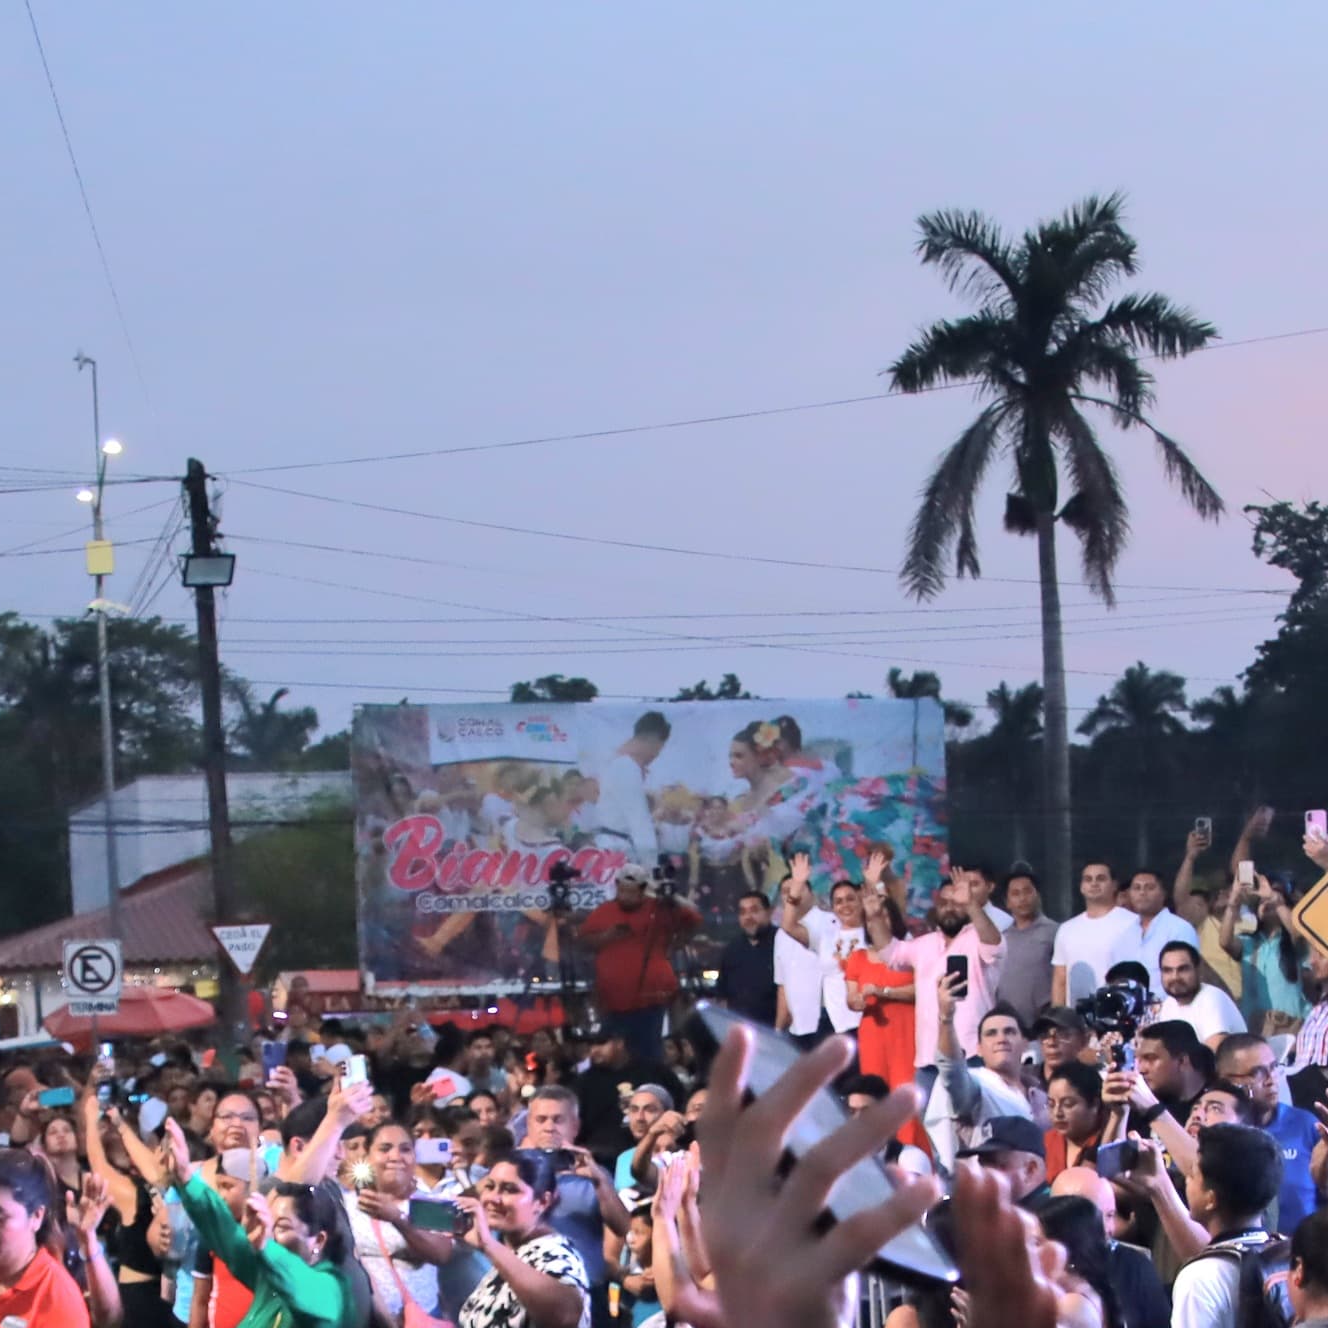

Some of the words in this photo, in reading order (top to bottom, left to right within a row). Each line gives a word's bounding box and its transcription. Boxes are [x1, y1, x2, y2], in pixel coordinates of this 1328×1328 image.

[457, 727, 504, 737] CALCO
[418, 893, 548, 910] Comalcalco
[565, 890, 608, 908] 025
[70, 1001, 116, 1013] TERMINA
